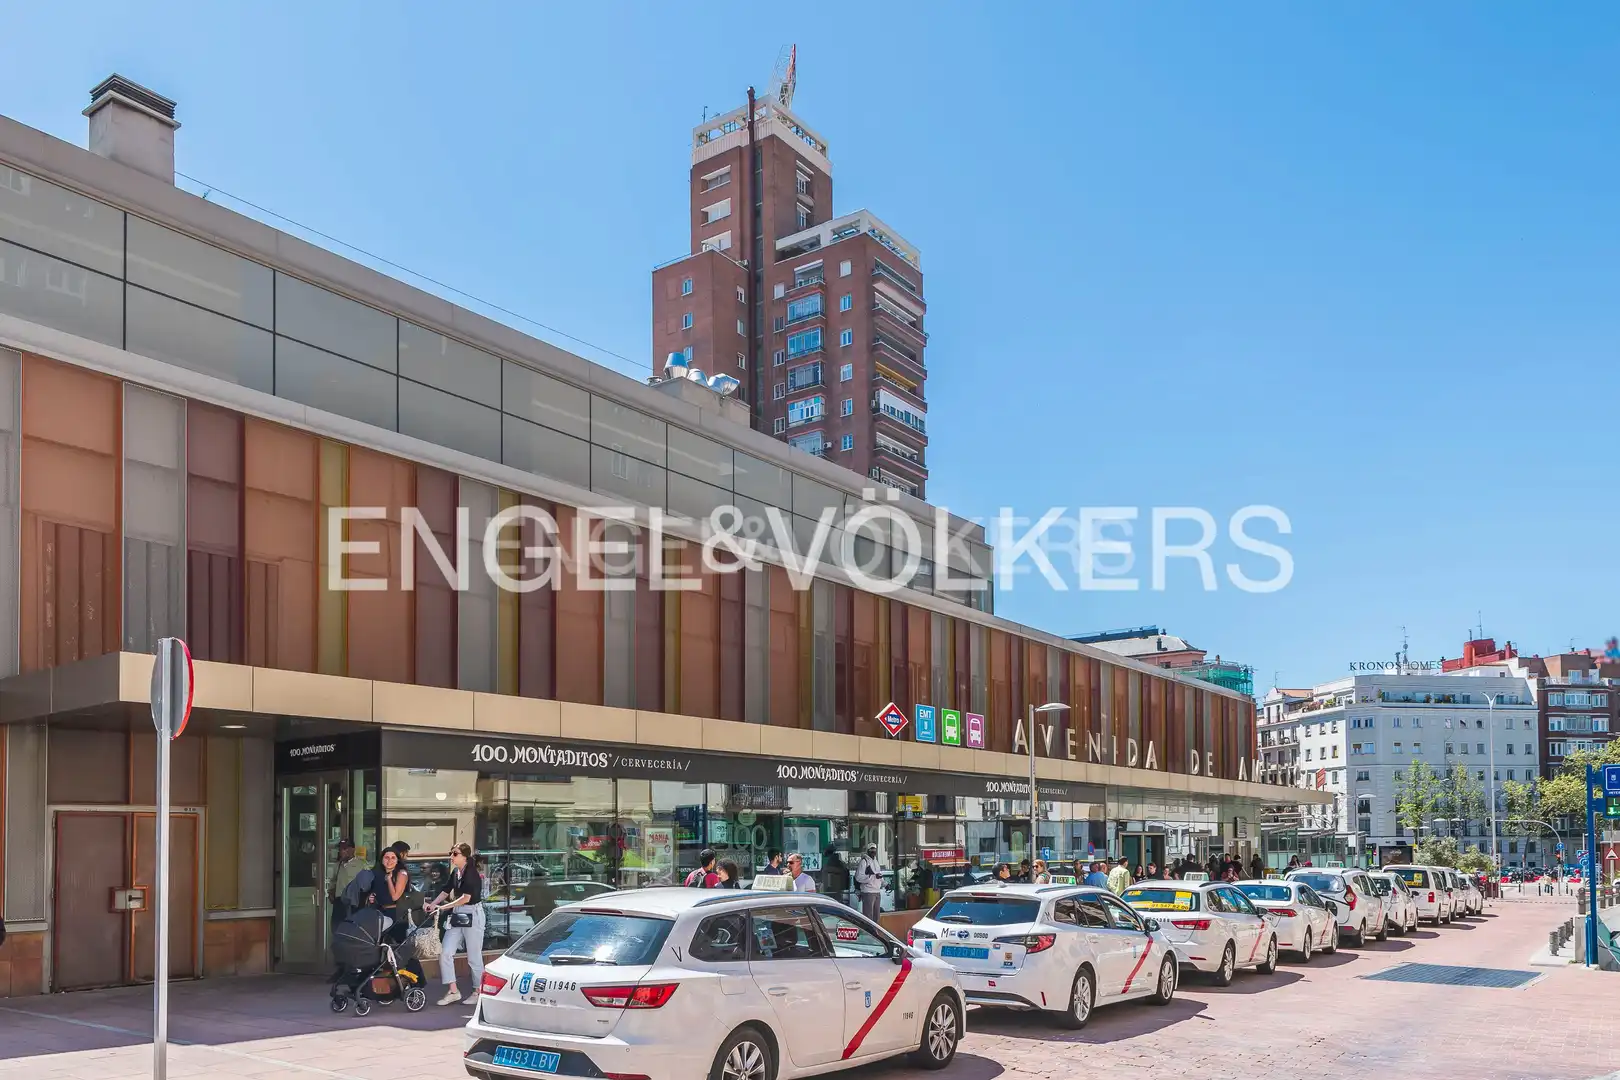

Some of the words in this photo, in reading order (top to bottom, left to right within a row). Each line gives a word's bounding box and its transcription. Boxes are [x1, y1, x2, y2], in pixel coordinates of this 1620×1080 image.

[1349, 661, 1401, 671] KRONOS
[920, 709, 932, 719] EMT
[471, 744, 508, 763] 100
[509, 744, 608, 768] MONTADITOS
[1013, 718, 1158, 770] AVENIDA
[1191, 749, 1214, 777] DE
[776, 764, 798, 779] 100
[798, 764, 857, 782] MONTADITOS
[986, 781, 999, 793] 100
[999, 780, 1031, 795] MONTADITO
[671, 946, 682, 962] V
[510, 972, 520, 990] V
[548, 980, 577, 992] 11946
[501, 1049, 528, 1065] 1193
[531, 1055, 557, 1070] LBV
